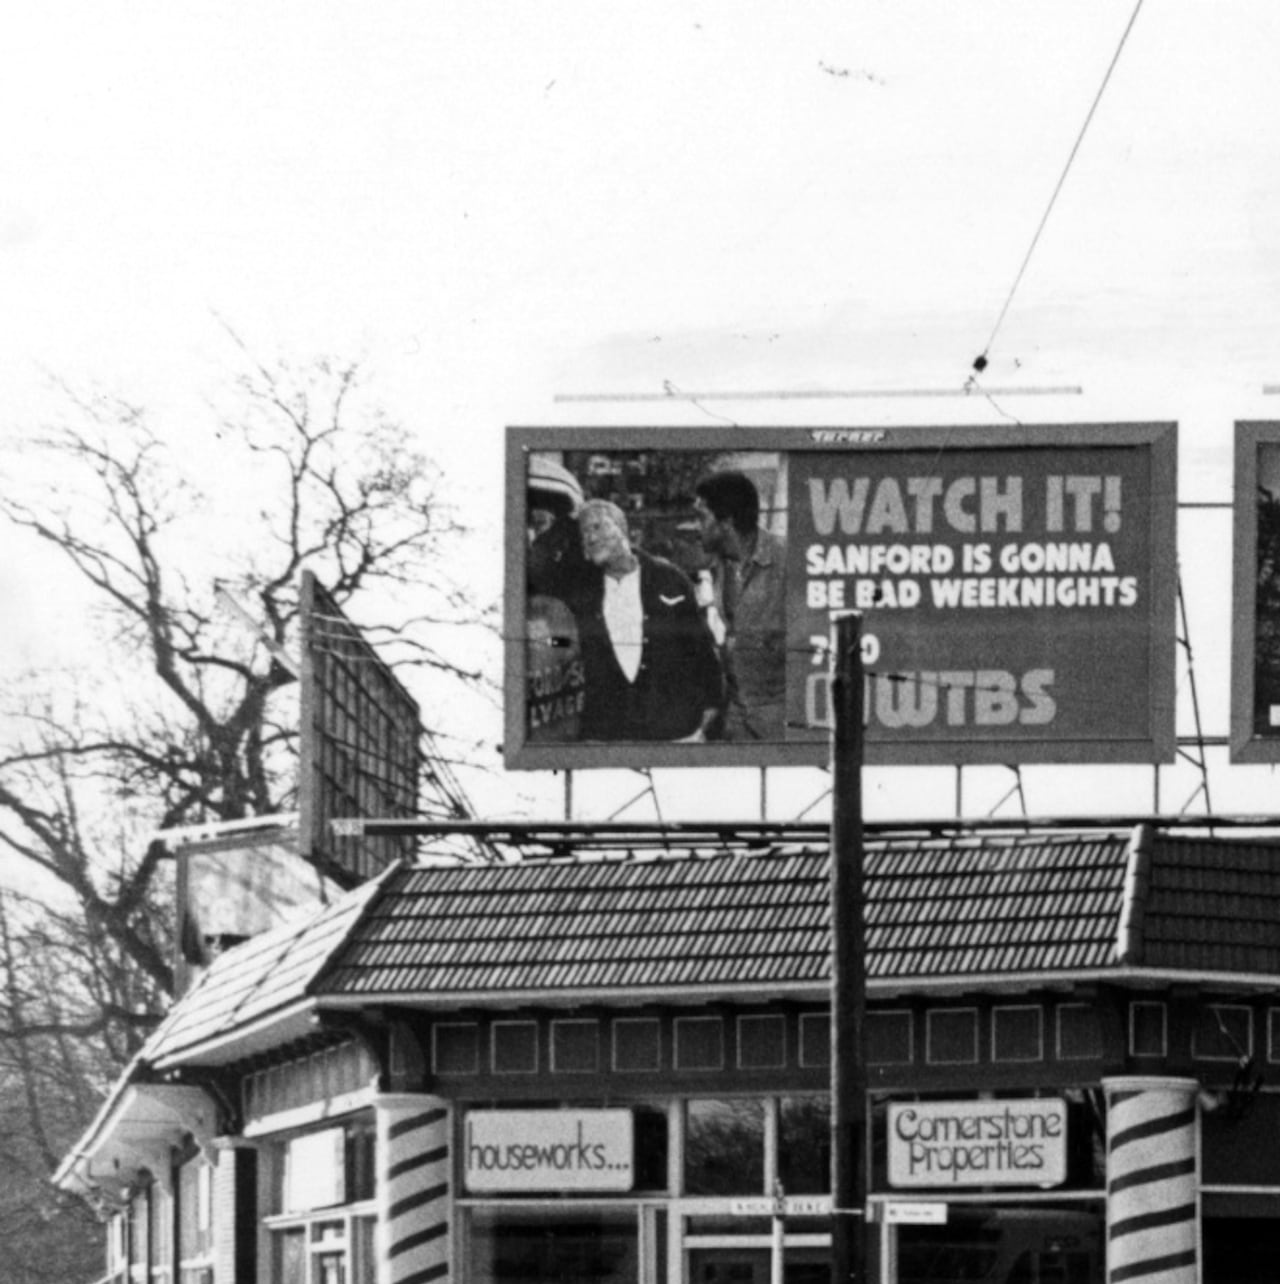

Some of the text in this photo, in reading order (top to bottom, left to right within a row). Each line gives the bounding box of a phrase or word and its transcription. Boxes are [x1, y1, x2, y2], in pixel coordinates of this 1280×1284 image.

[807, 475, 1122, 535] WATCH IT!
[806, 542, 1115, 575] SANFORD IS GONNA
[806, 577, 1138, 609] BE BAD WEEKNIGHTS
[875, 669, 1057, 728] WTBS
[895, 1106, 1062, 1142] Cornerstone
[909, 1140, 1045, 1182] Properties
